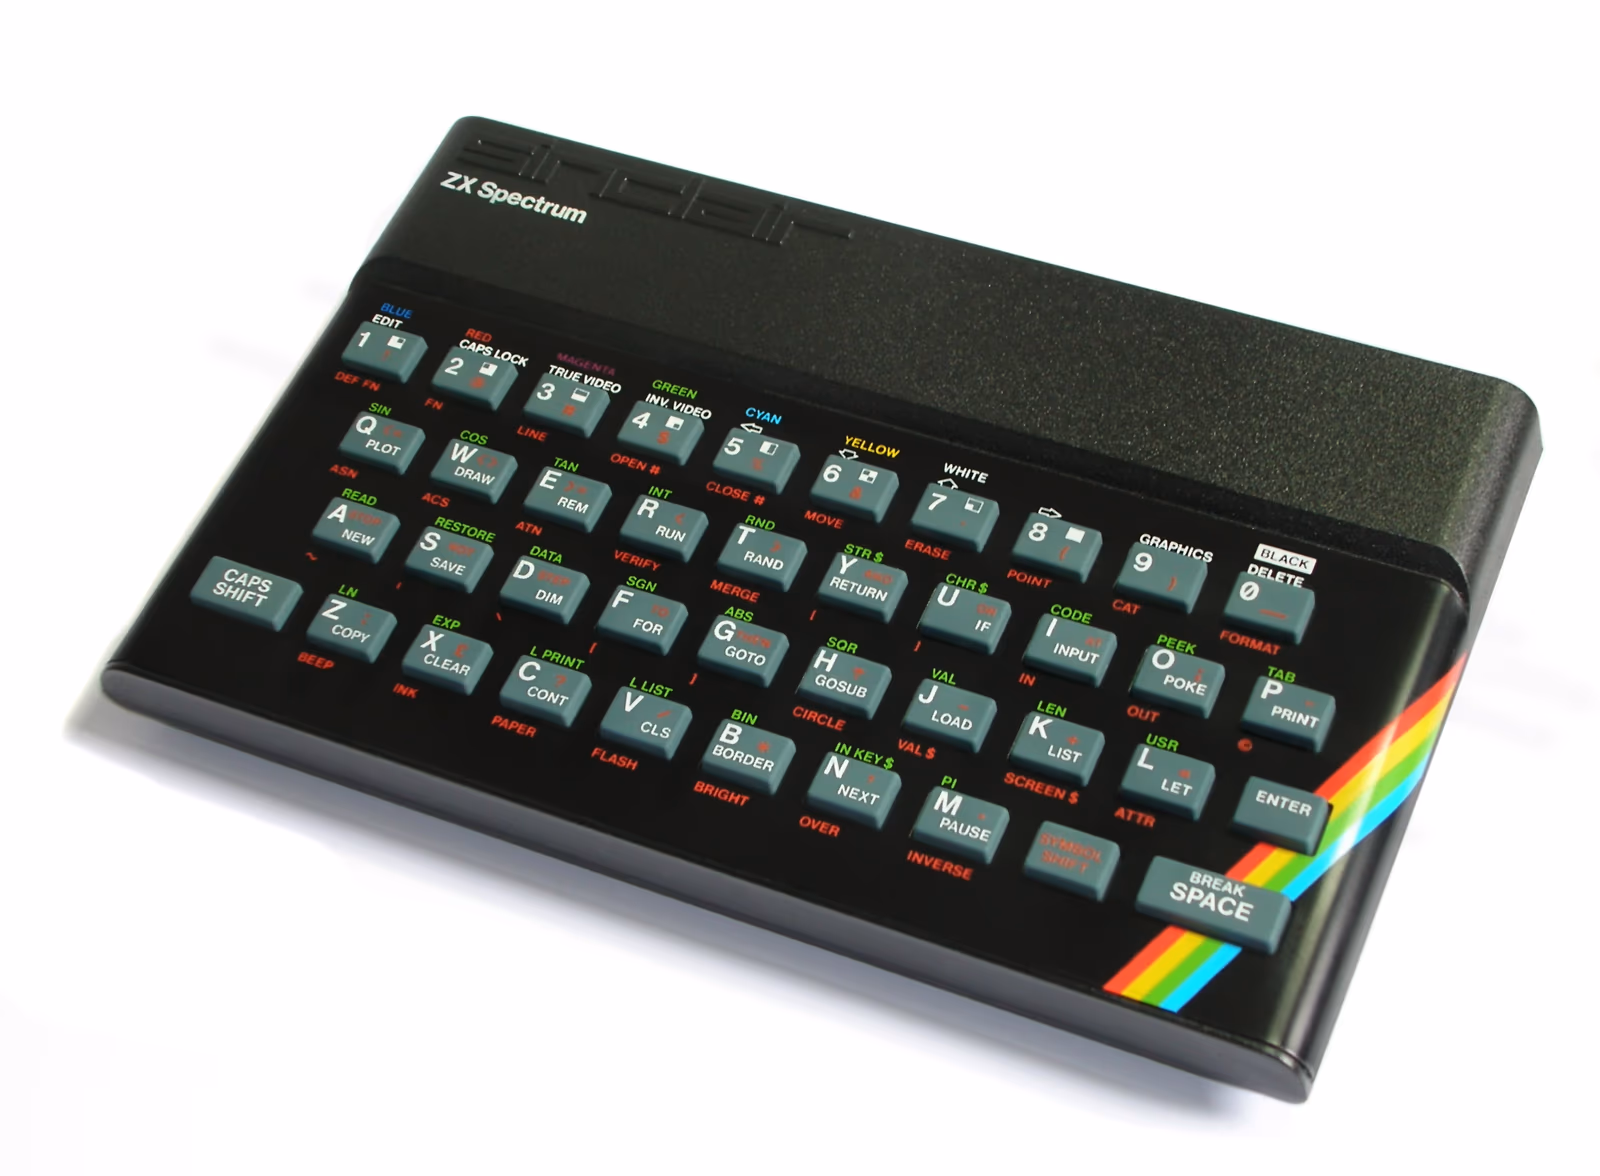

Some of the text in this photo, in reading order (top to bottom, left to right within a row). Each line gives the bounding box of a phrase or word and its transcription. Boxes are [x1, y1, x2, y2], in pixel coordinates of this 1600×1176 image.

[440, 172, 588, 225] ZX Spectrum
[381, 302, 413, 319] BLUE
[372, 314, 403, 329] EDIT
[356, 332, 371, 348] 1
[465, 328, 492, 342] RED
[459, 339, 529, 368] CAPS LOCK
[444, 357, 464, 376] 2
[557, 352, 616, 376] MAGENTA
[334, 371, 381, 392] DEF FN
[548, 365, 622, 394] TRUE VIDEO
[652, 379, 698, 399] GREEN
[536, 383, 555, 400] 3
[368, 402, 392, 416] SIN
[424, 397, 444, 411] FN
[645, 393, 712, 420] INV. VIDEO
[355, 416, 377, 436] Q
[632, 412, 649, 429] 4
[746, 407, 782, 425] CYAN
[460, 430, 488, 445] COS
[517, 426, 546, 442] LINE
[365, 439, 402, 456] PLOT
[449, 443, 479, 463] W
[724, 437, 744, 456] 5
[844, 436, 901, 458] YELLOW
[329, 464, 358, 480] ASN
[554, 457, 579, 472] TAN
[610, 453, 648, 472] OPEN
[454, 466, 496, 485] DRAW
[539, 471, 557, 489] E
[822, 465, 842, 483] 6
[943, 463, 989, 483] WHITE
[342, 488, 378, 506] READ
[421, 492, 450, 508] ACS
[648, 485, 673, 499] INT
[706, 481, 750, 501] CLOSE
[557, 496, 589, 514] REM
[637, 499, 659, 519] R
[928, 493, 947, 510] 7
[326, 504, 347, 523] A
[745, 514, 776, 531] RND
[804, 510, 845, 529] MOVE
[341, 528, 376, 546] NEW
[434, 516, 496, 542] RESTORE
[516, 521, 543, 536] ATN
[655, 525, 686, 542] RUN
[737, 526, 756, 544] T
[1028, 523, 1049, 542] 8
[419, 532, 441, 551] S
[844, 543, 872, 560] STR
[904, 539, 950, 560] ERASE
[1139, 534, 1214, 563] GRAPHICS
[530, 546, 564, 564] DATA
[614, 550, 662, 572] VERIFY
[744, 551, 784, 571] RAND
[839, 555, 858, 575] Y
[1133, 553, 1153, 572] 9
[1259, 547, 1311, 570] BLACK
[430, 557, 466, 576] SAVE
[513, 559, 535, 580] D
[1247, 564, 1305, 588] DELETE
[223, 568, 274, 593] CAPS
[626, 576, 657, 593] SGN
[946, 573, 977, 591] CHR
[1007, 569, 1052, 588] POINT
[212, 582, 268, 608] SHIFT
[338, 584, 358, 598] LN
[535, 589, 563, 606] DIM
[611, 588, 634, 608] F
[710, 580, 761, 603] MERGE
[829, 576, 888, 602] RETURN
[936, 587, 960, 607] U
[322, 600, 345, 620] Z
[724, 606, 754, 622] ABS
[1050, 604, 1093, 624] CODE
[1112, 599, 1141, 615] CAT
[432, 615, 461, 630] EXP
[632, 618, 664, 636] FOR
[713, 620, 736, 641] G
[974, 619, 992, 632] IF
[331, 624, 371, 644] COPY
[420, 631, 444, 652] X
[1219, 630, 1282, 655] FORMAT
[826, 636, 858, 654] SQR
[1053, 642, 1100, 665] INPUT
[1157, 635, 1197, 654] PEEK
[297, 652, 334, 670] BEEP
[423, 654, 471, 677] CLEAR
[530, 646, 585, 670] L PRINT
[724, 645, 767, 666] GOTO
[814, 650, 838, 672] H
[1152, 649, 1175, 669] O
[518, 661, 541, 682] C
[932, 668, 956, 685] VAL
[1018, 673, 1036, 687] IN
[1267, 666, 1297, 683] TAB
[392, 683, 419, 699] INK
[526, 685, 569, 706] CONT
[629, 677, 674, 698] L LIST
[814, 674, 868, 699] GOSUB
[918, 686, 937, 704] J
[1164, 675, 1207, 696] POKE
[1260, 679, 1283, 699] P
[623, 693, 644, 713] V
[1037, 700, 1067, 718] LEN
[731, 709, 758, 725] BIN
[792, 706, 845, 731] CIRCLE
[931, 710, 973, 731] LOAD
[1127, 705, 1160, 723] OUT
[1271, 705, 1321, 729] PRINT
[491, 715, 536, 738] PAPER
[640, 722, 671, 739] CLS
[719, 724, 740, 745] B
[1028, 717, 1052, 739] K
[898, 739, 925, 756] VAL
[1146, 733, 1180, 752] USR
[591, 747, 639, 770] FLASH
[712, 744, 775, 772] BORDER
[834, 742, 884, 765] IN KEY
[1048, 744, 1083, 763] LIST
[1137, 748, 1154, 769] L
[823, 757, 850, 779] N
[941, 775, 958, 789] PI
[1003, 772, 1066, 800] SCREEN
[1161, 778, 1193, 797] LET
[694, 781, 750, 807] BRIGHT
[837, 784, 880, 805] NEXT
[933, 790, 962, 816] M
[1255, 790, 1312, 817] ENTER
[799, 816, 841, 837] OVER
[1113, 807, 1157, 828] ATTR
[939, 817, 992, 842] PAUSE
[1040, 833, 1102, 863] SYMBOL
[907, 850, 972, 881] INVERSE
[1041, 851, 1088, 874] SHIFT
[1189, 871, 1247, 897] BREAK
[1169, 882, 1255, 922] SPACE
